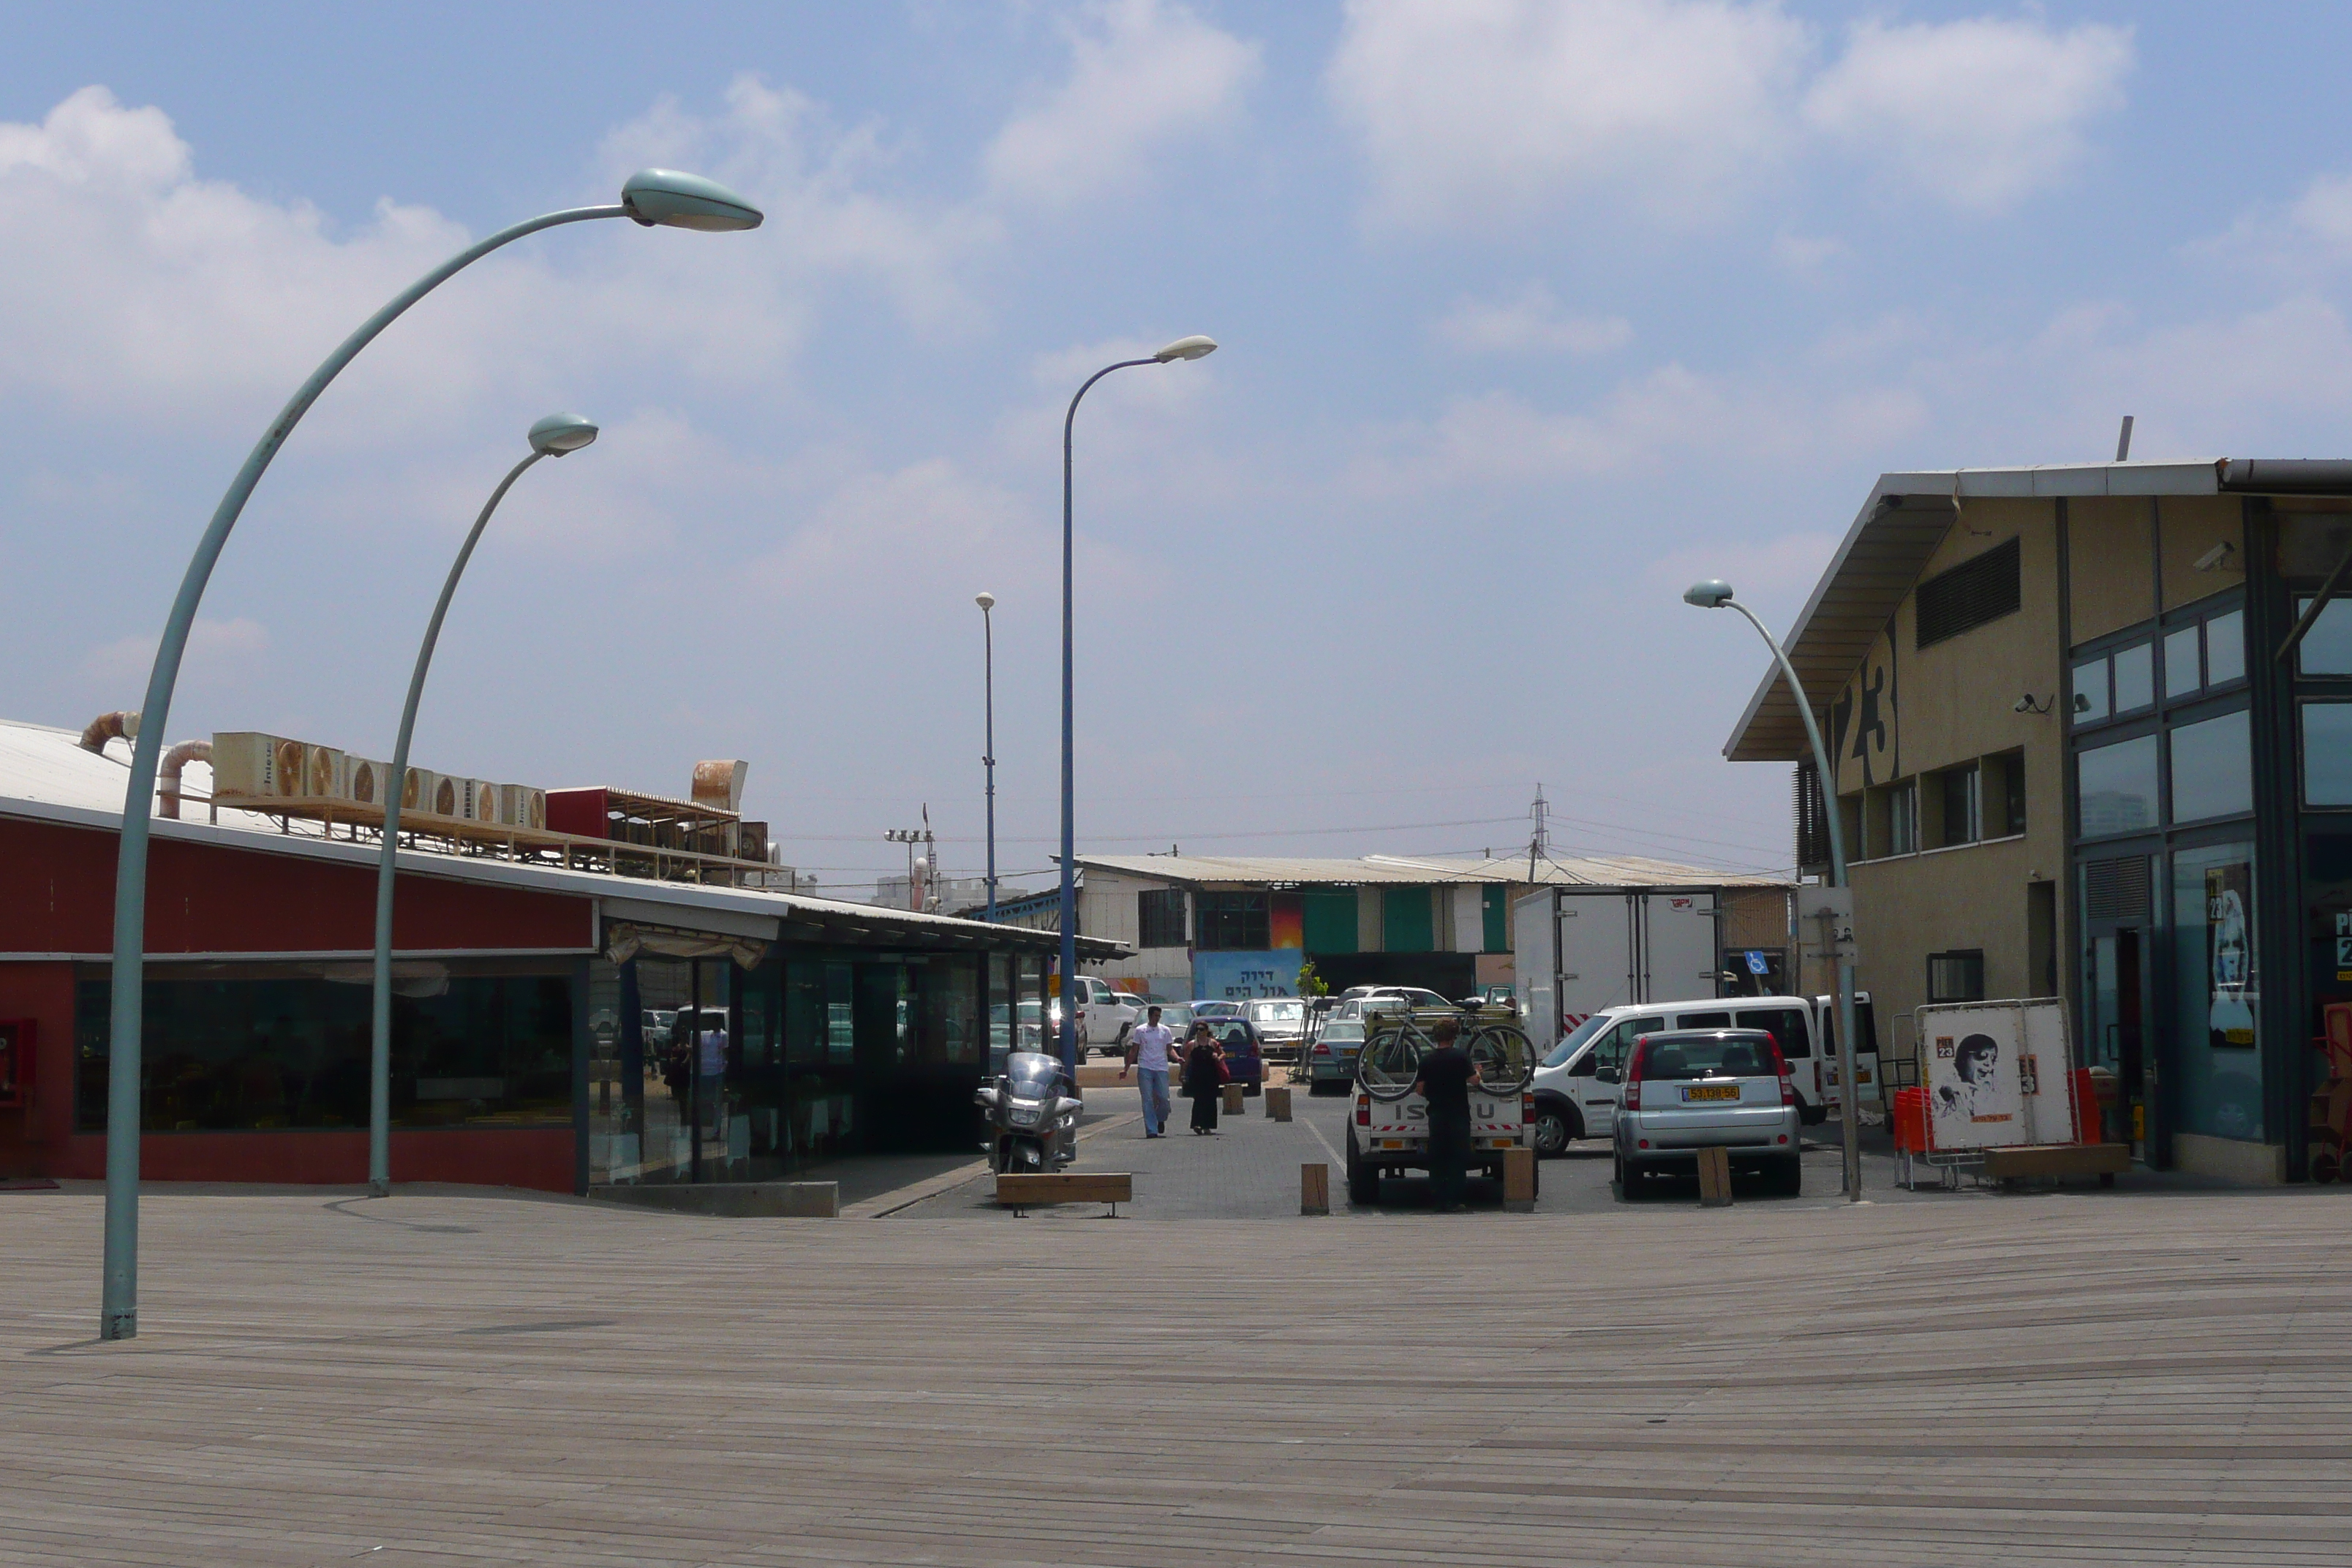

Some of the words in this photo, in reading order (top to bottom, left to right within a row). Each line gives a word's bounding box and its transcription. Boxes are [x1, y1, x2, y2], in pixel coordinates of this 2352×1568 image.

[1832, 629, 1897, 796] 23
[2210, 897, 2223, 919] 23
[1240, 970, 1274, 984] דיוק
[1225, 986, 1251, 997] הים
[1939, 1047, 1953, 1057] 23
[1395, 1104, 1495, 1120] ISU
